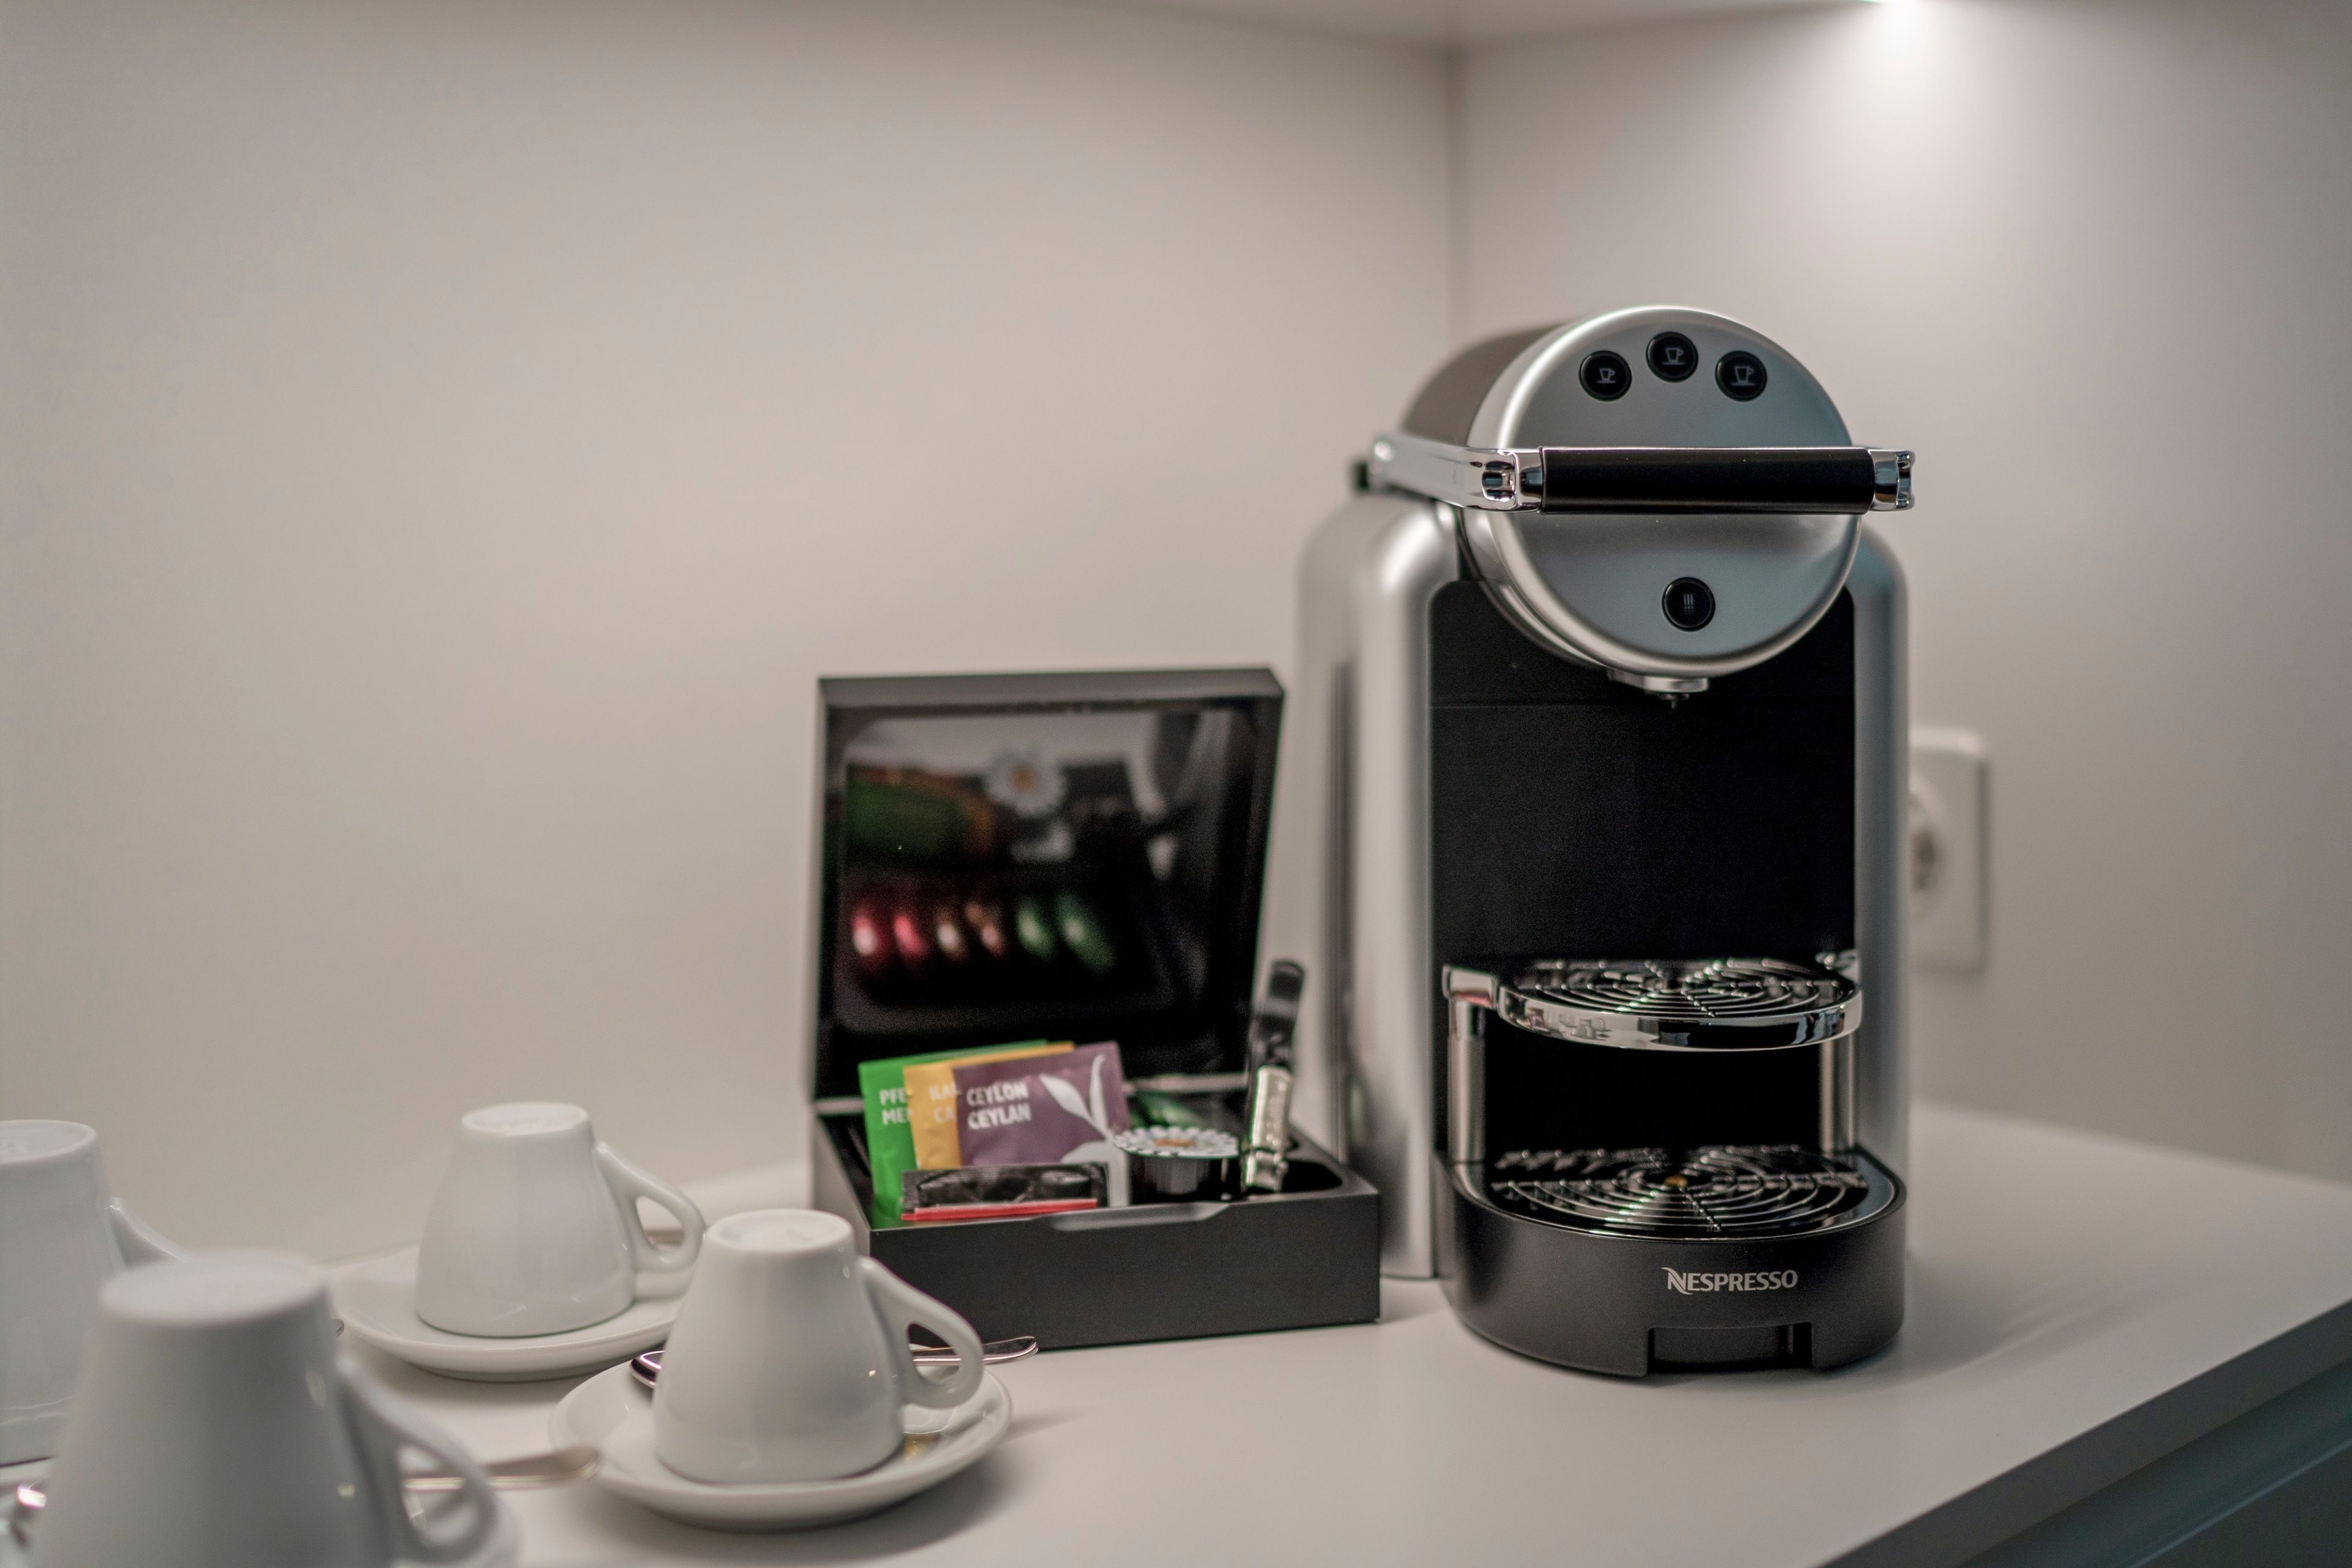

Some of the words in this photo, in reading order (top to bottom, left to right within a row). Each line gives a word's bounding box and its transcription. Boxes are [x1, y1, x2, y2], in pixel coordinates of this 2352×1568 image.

[968, 1081, 1028, 1106] CEYLON
[968, 1104, 1031, 1129] CEYLAN
[1661, 1267, 1798, 1295] NESPRESSO
